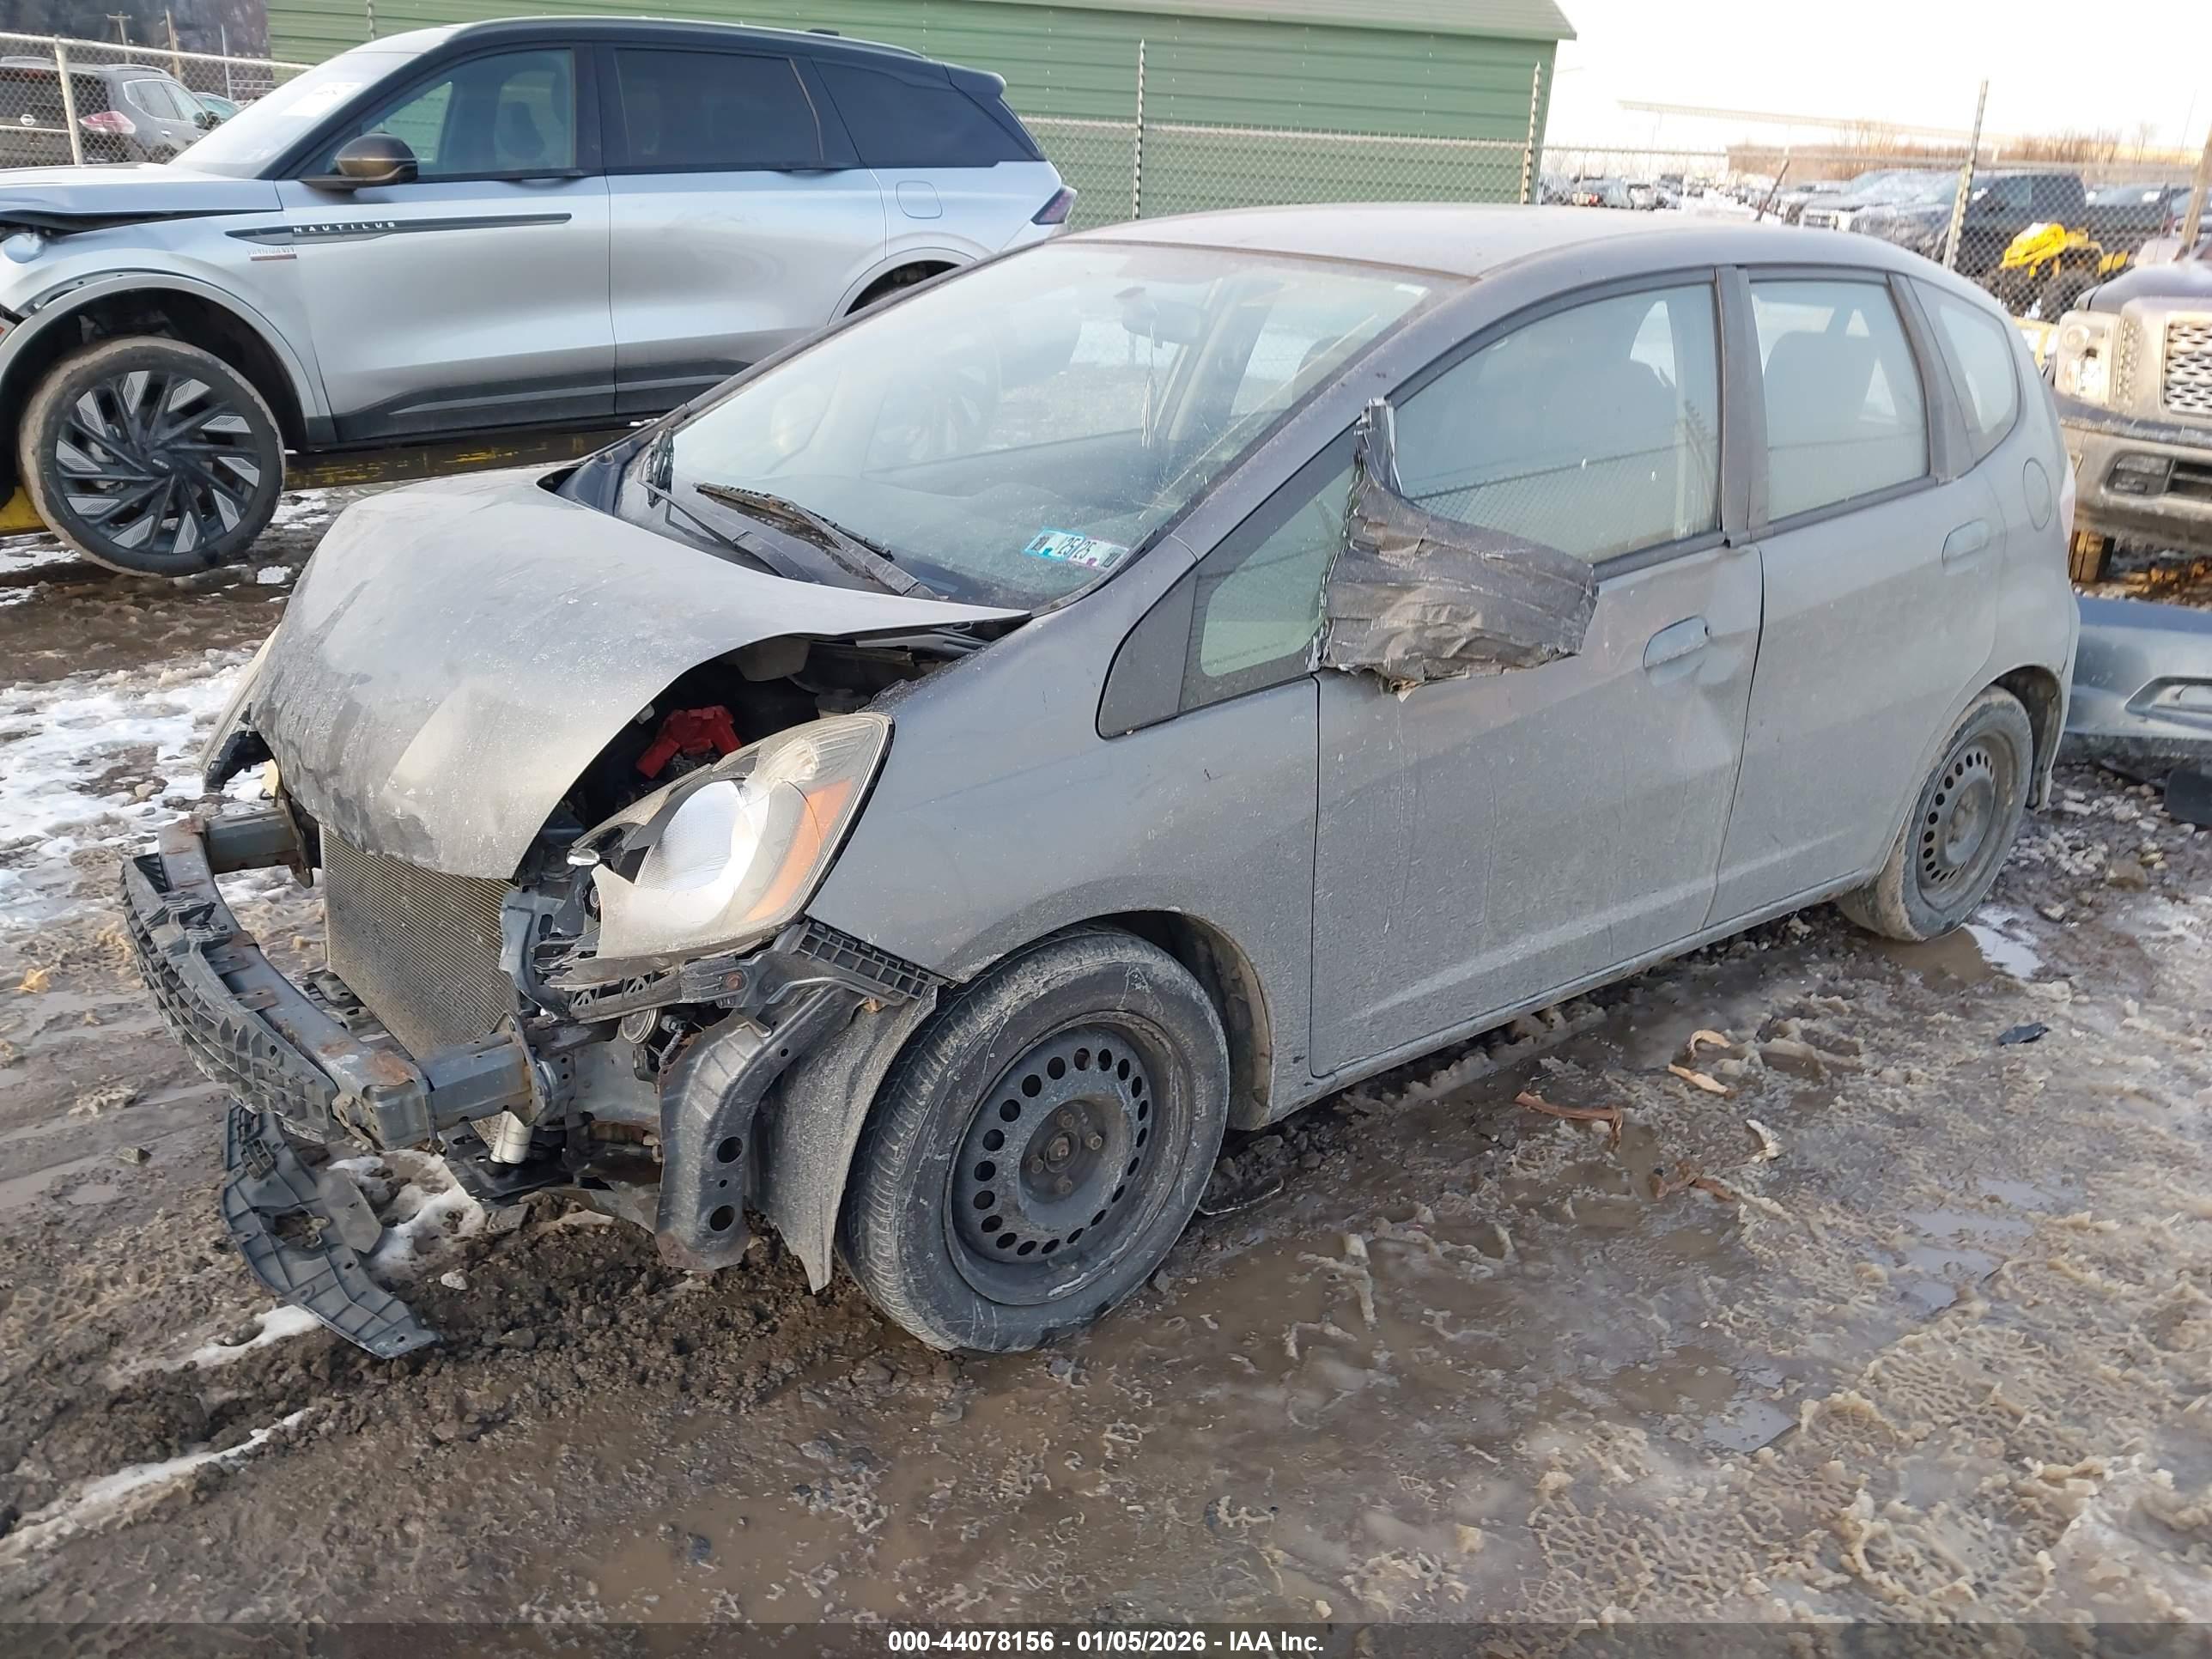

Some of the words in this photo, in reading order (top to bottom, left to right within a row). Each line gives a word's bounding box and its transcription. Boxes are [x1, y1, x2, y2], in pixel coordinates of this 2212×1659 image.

[293, 222, 396, 234] NAUTILUS
[1057, 537, 1081, 556] 25
[1073, 540, 1097, 559] 25
